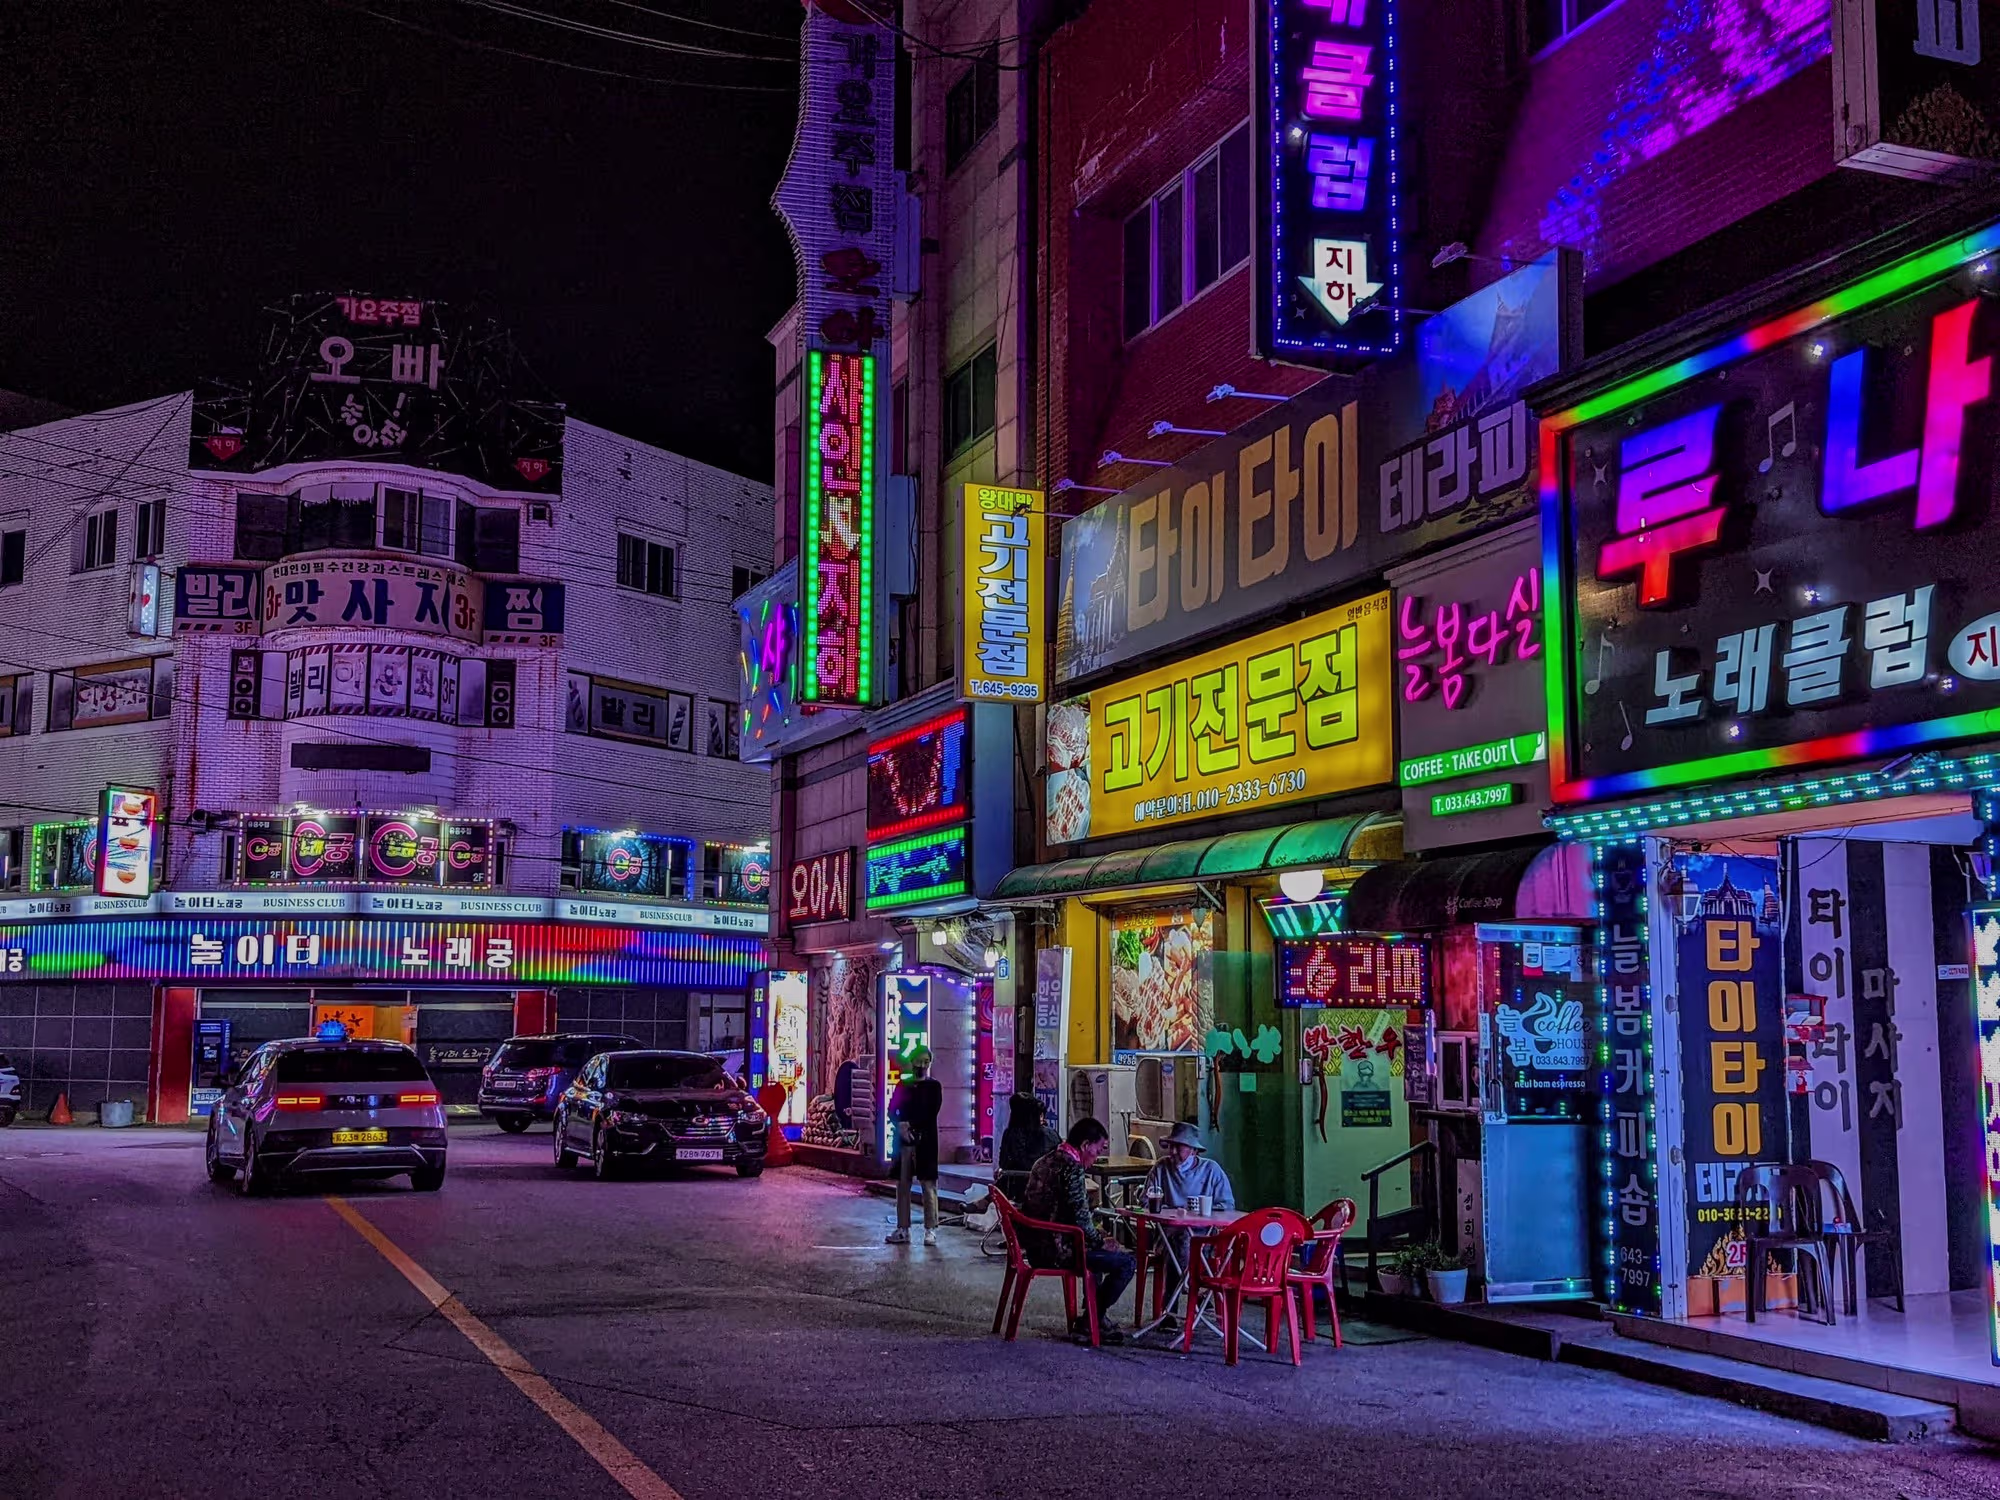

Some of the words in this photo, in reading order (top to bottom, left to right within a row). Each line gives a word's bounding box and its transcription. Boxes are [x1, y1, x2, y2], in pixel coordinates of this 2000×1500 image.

[1326, 246, 1356, 309] 지하
[335, 297, 421, 326] 가요주점
[310, 335, 446, 390] 오빠
[1596, 297, 1992, 606] 루나
[1127, 400, 1359, 632] 타이타이
[1380, 399, 1527, 533] 테라피
[184, 572, 258, 621] 발리
[265, 585, 282, 621] 3F
[285, 578, 451, 633] 맛사지
[505, 587, 543, 630] 찜
[974, 512, 1031, 677] 고기전문점
[1347, 596, 1388, 621] 일반음식점
[234, 621, 253, 634] 3F
[540, 634, 557, 647] 3F
[1398, 567, 1541, 710] 늘봄다실
[1644, 584, 1937, 726] 노래클럽
[290, 664, 326, 700] 발리
[441, 677, 455, 705] 3F
[971, 680, 1038, 698] T.645-9295
[1103, 622, 1359, 793] 고기전문점
[1404, 758, 1443, 781] COFFEE
[1451, 750, 1482, 771] TAKE
[1483, 744, 1508, 765] OUT
[270, 870, 281, 879] 2F
[472, 873, 484, 881] 2F
[789, 851, 849, 920] 오아시
[94, 901, 129, 911] BUSINESS
[129, 899, 148, 909] CLUB
[263, 898, 313, 908] BUSINESS
[314, 898, 345, 908] CLUB
[461, 901, 512, 911] BUSINESS
[513, 903, 542, 913] CLUB
[640, 910, 673, 920] BUSINESS
[673, 911, 693, 921] CLUB
[190, 933, 320, 966] 놀이터
[401, 936, 514, 969] 노래궁
[1037, 980, 1061, 1004] 한우
[1036, 1004, 1060, 1028] 등심
[1538, 1004, 1592, 1034] coffee
[1808, 888, 1851, 1132] 타이타이
[1557, 1037, 1592, 1050] HOUSE
[1705, 919, 1766, 1156] 타이타이
[1862, 968, 1903, 1132] 마사지
[1535, 1055, 1590, 1066] 033.643.7997
[1611, 923, 1650, 1226] 늘봄커피숍
[1514, 1079, 1533, 1089] neul
[1533, 1079, 1551, 1089] bom
[1551, 1079, 1586, 1092] espresso
[361, 1132, 384, 1141] 2863
[1620, 1245, 1651, 1265] 643-
[1621, 1267, 1652, 1289] 7997
